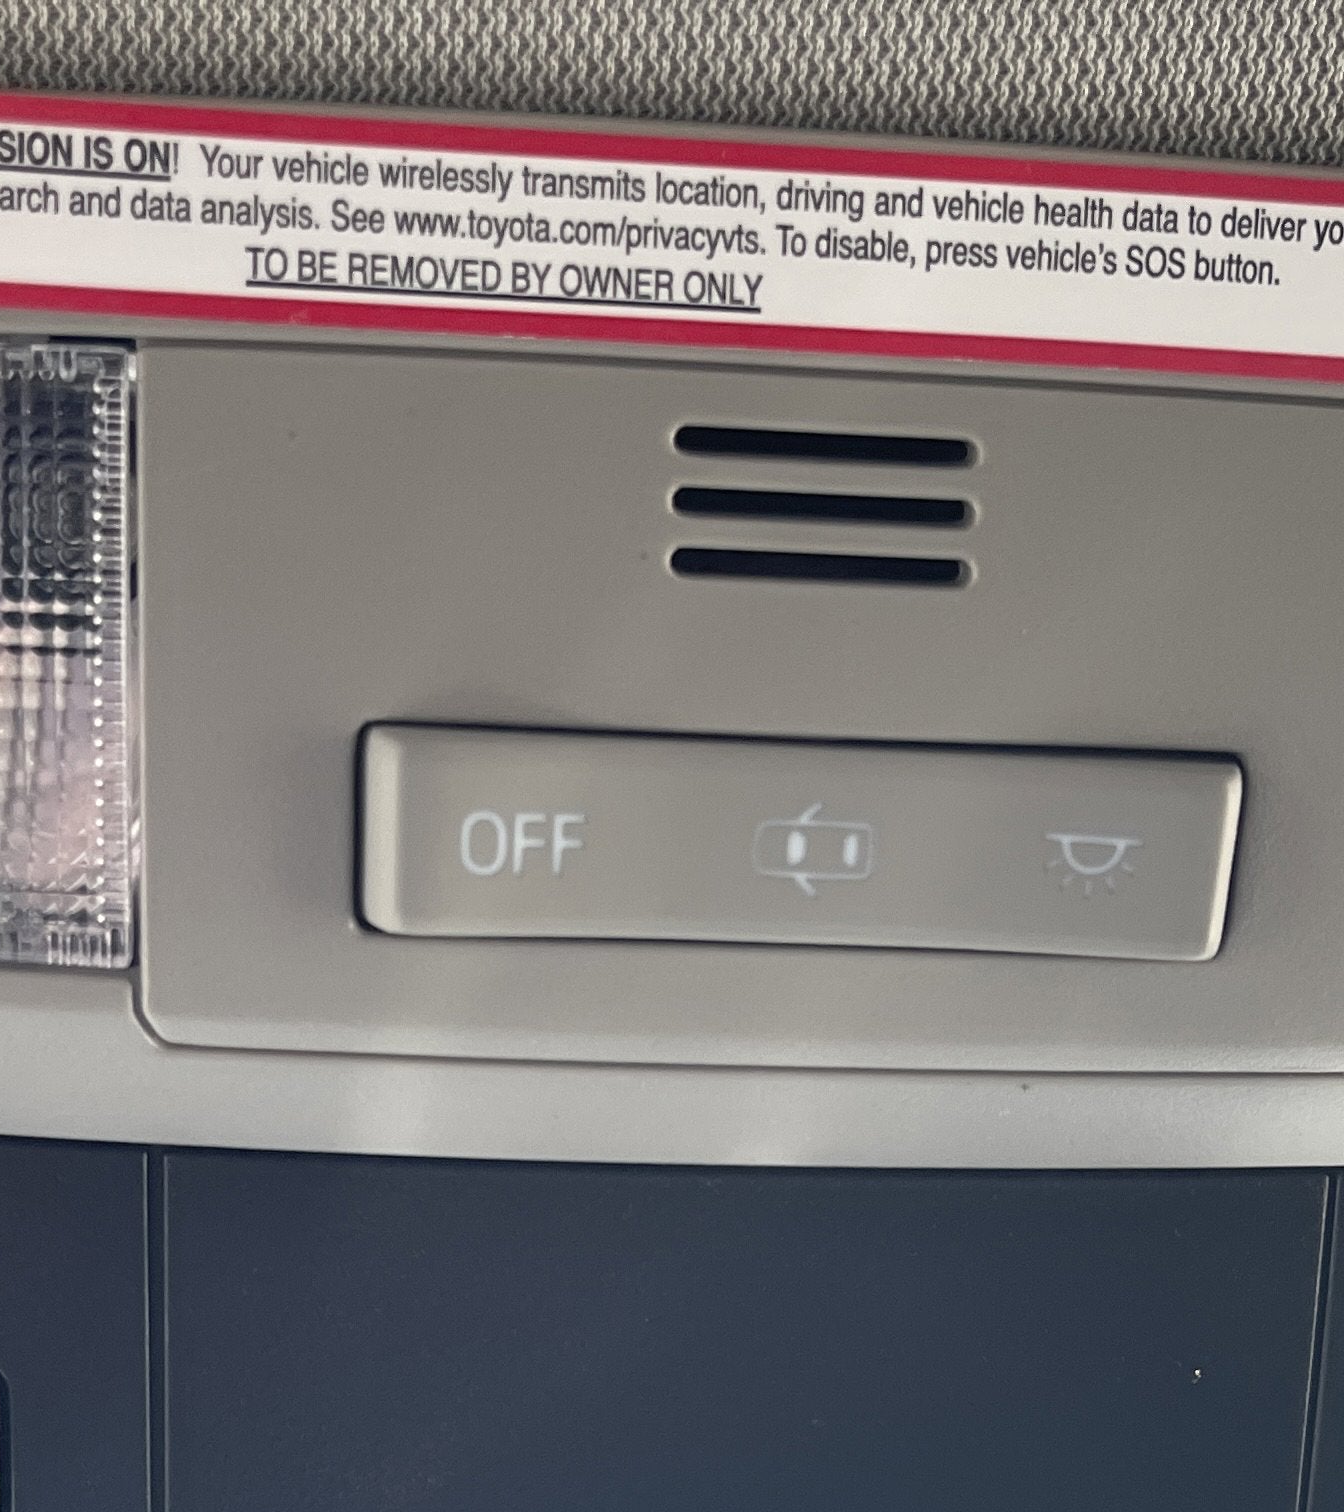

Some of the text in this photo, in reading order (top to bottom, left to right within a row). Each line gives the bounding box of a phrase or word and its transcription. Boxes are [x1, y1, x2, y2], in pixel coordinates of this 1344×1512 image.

[84, 133, 114, 171] IS
[123, 138, 180, 175] ON!
[200, 144, 263, 179] Your
[272, 150, 369, 186] vehicle
[379, 157, 513, 202] wirelessly
[522, 166, 646, 202] transmits
[656, 171, 765, 214] location,
[776, 179, 864, 222] driving
[874, 186, 923, 218] and
[933, 189, 1024, 224] vehicle
[1034, 194, 1113, 230] health
[1122, 200, 1178, 234] data
[1188, 205, 1212, 236] to
[1221, 206, 1307, 242] deliver
[69, 178, 121, 218] and
[130, 188, 191, 222] data
[201, 194, 319, 235] analysis.
[331, 199, 385, 233] See
[394, 202, 765, 260] www.toyota.com/privacyvts.
[776, 224, 807, 257] To
[815, 227, 915, 268] disable,
[925, 240, 998, 272] press
[1006, 239, 1117, 275] vehicle's
[1125, 244, 1185, 279] SOS
[1194, 249, 1280, 285] button.
[246, 247, 763, 307] TO BE REMOVED BY OWNER ONLY
[461, 811, 586, 875] OFF
